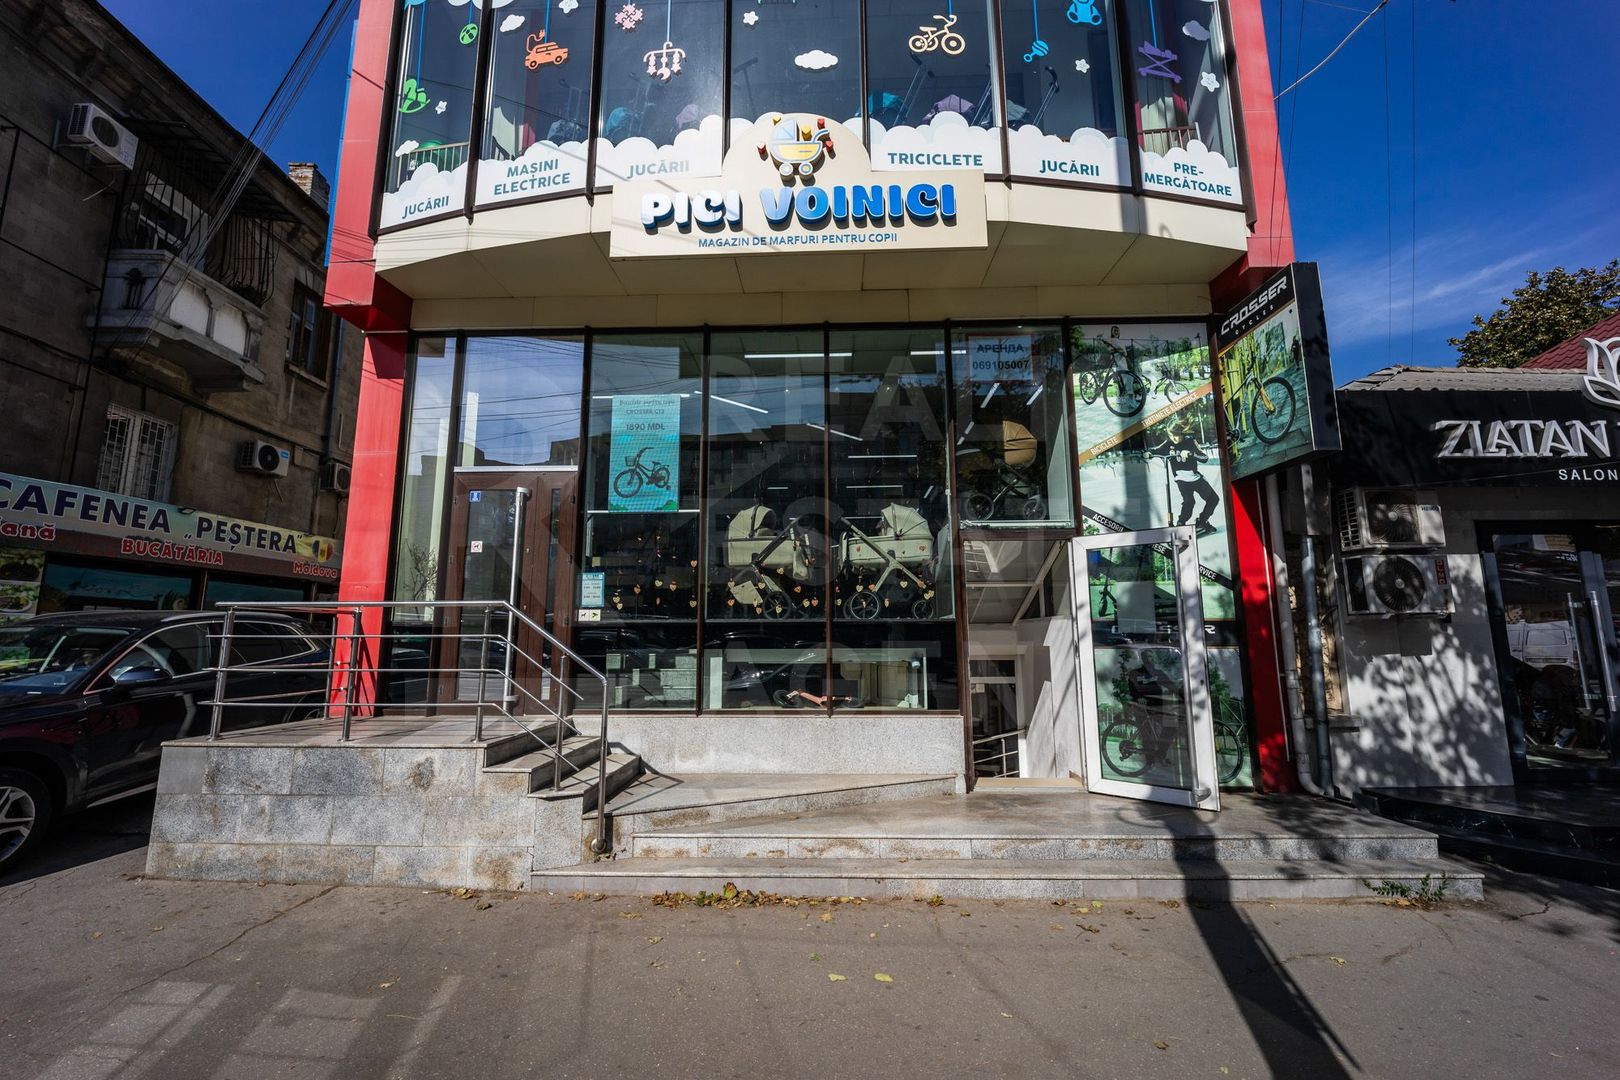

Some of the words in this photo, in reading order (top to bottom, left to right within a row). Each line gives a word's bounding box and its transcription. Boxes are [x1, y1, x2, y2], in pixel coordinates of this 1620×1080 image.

[888, 152, 983, 166] TRICICLETE
[1040, 160, 1099, 176] JUCĂRII
[627, 160, 689, 178] JUCĂRII
[1173, 162, 1204, 177] PRE-
[494, 172, 571, 195] ELECTRICE
[1144, 172, 1232, 196] MERGĂTOARE
[402, 195, 449, 219] JUCĂRII
[641, 190, 742, 230] PICI
[759, 184, 957, 223] VOINICI
[698, 235, 749, 248] MAGAZIN
[752, 236, 767, 246] DE
[769, 235, 818, 246] MARFURI
[822, 233, 866, 244] PENTRU
[869, 232, 898, 243] COPII
[1220, 276, 1287, 336] CROSSER
[1235, 304, 1274, 335] CYCLES
[976, 343, 1024, 354] АРЕНДА
[972, 360, 1030, 370] 069105007
[626, 423, 646, 431] 1890
[1431, 420, 1612, 459] ZLATAN
[1558, 469, 1619, 481] SALON
[0, 521, 56, 541] ană
[121, 539, 225, 565] BUCĂTĂRIA
[1199, 566, 1217, 580] RVICE
